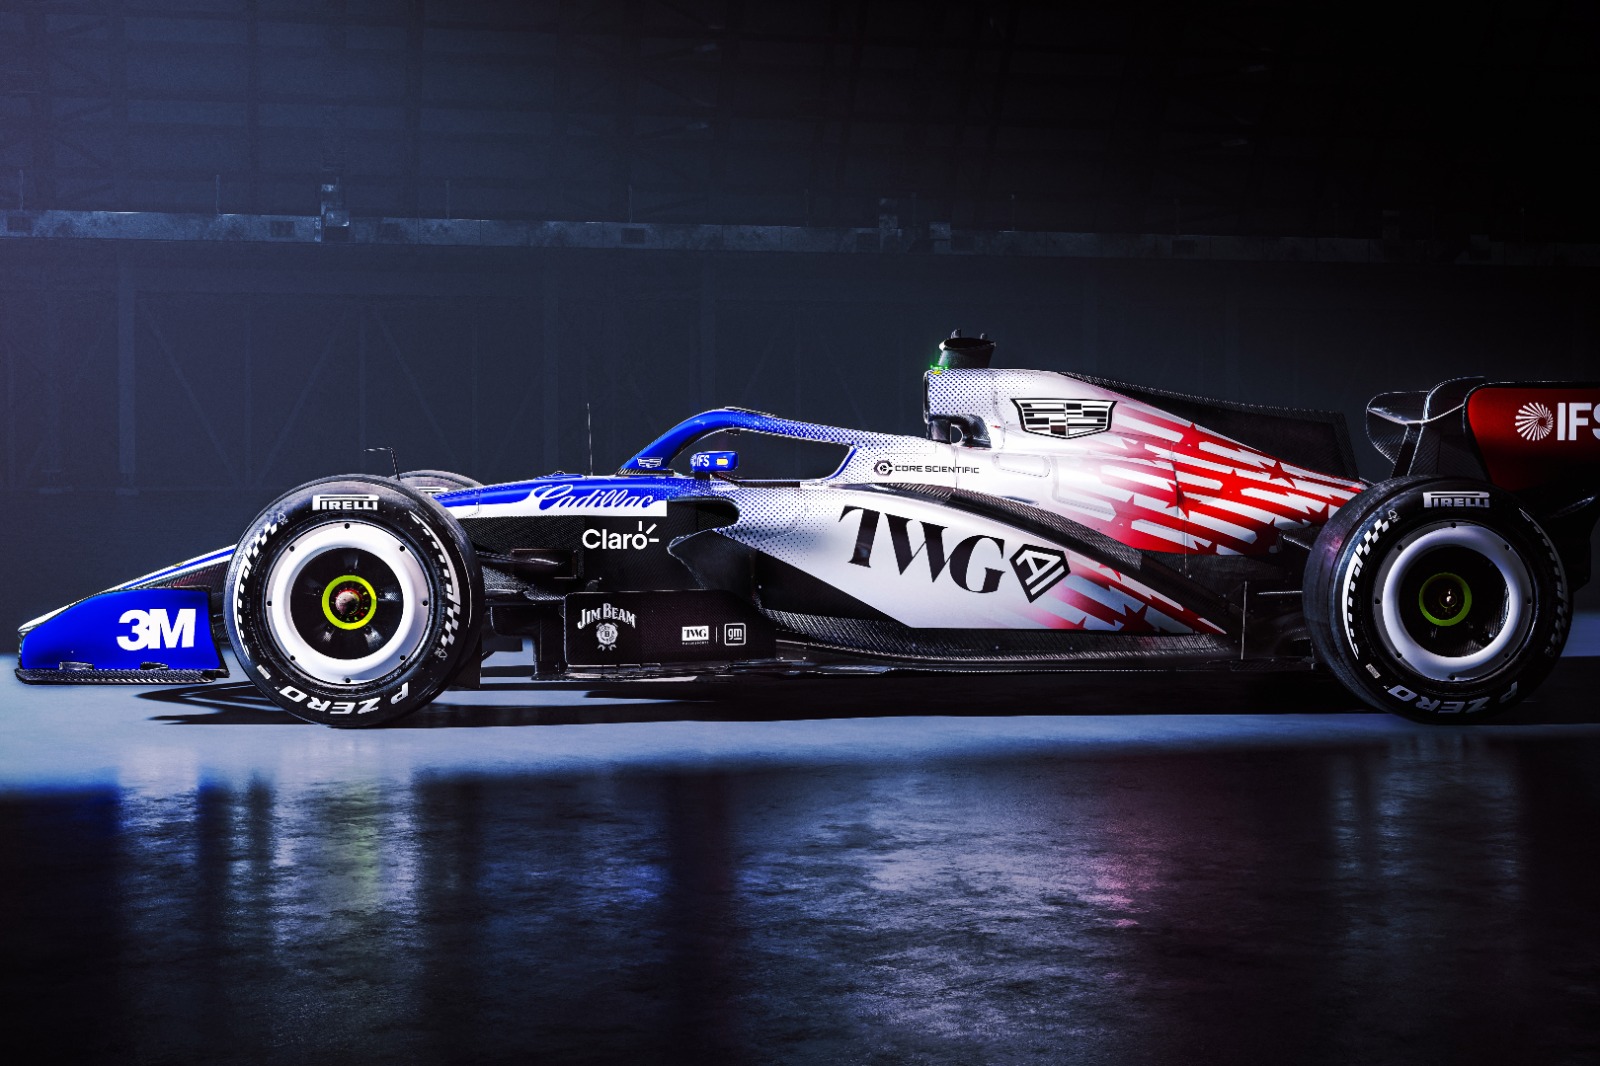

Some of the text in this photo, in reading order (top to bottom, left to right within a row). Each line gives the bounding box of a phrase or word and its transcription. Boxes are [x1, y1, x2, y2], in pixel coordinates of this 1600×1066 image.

[1557, 402, 1600, 441] IF
[895, 465, 980, 474] CORE SCIENTIFIC
[312, 494, 379, 511] PIRELLI
[534, 484, 655, 511] Cadillac
[1423, 491, 1490, 508] PIRELLI
[582, 528, 648, 551] Claro
[838, 505, 1006, 594] TWG
[116, 608, 196, 650] 3M
[577, 602, 637, 630] JIM BEAM
[684, 629, 707, 638] TWG
[728, 628, 743, 641] gm
[279, 682, 409, 715] P ZERO
[1387, 684, 1491, 714] ZERO
